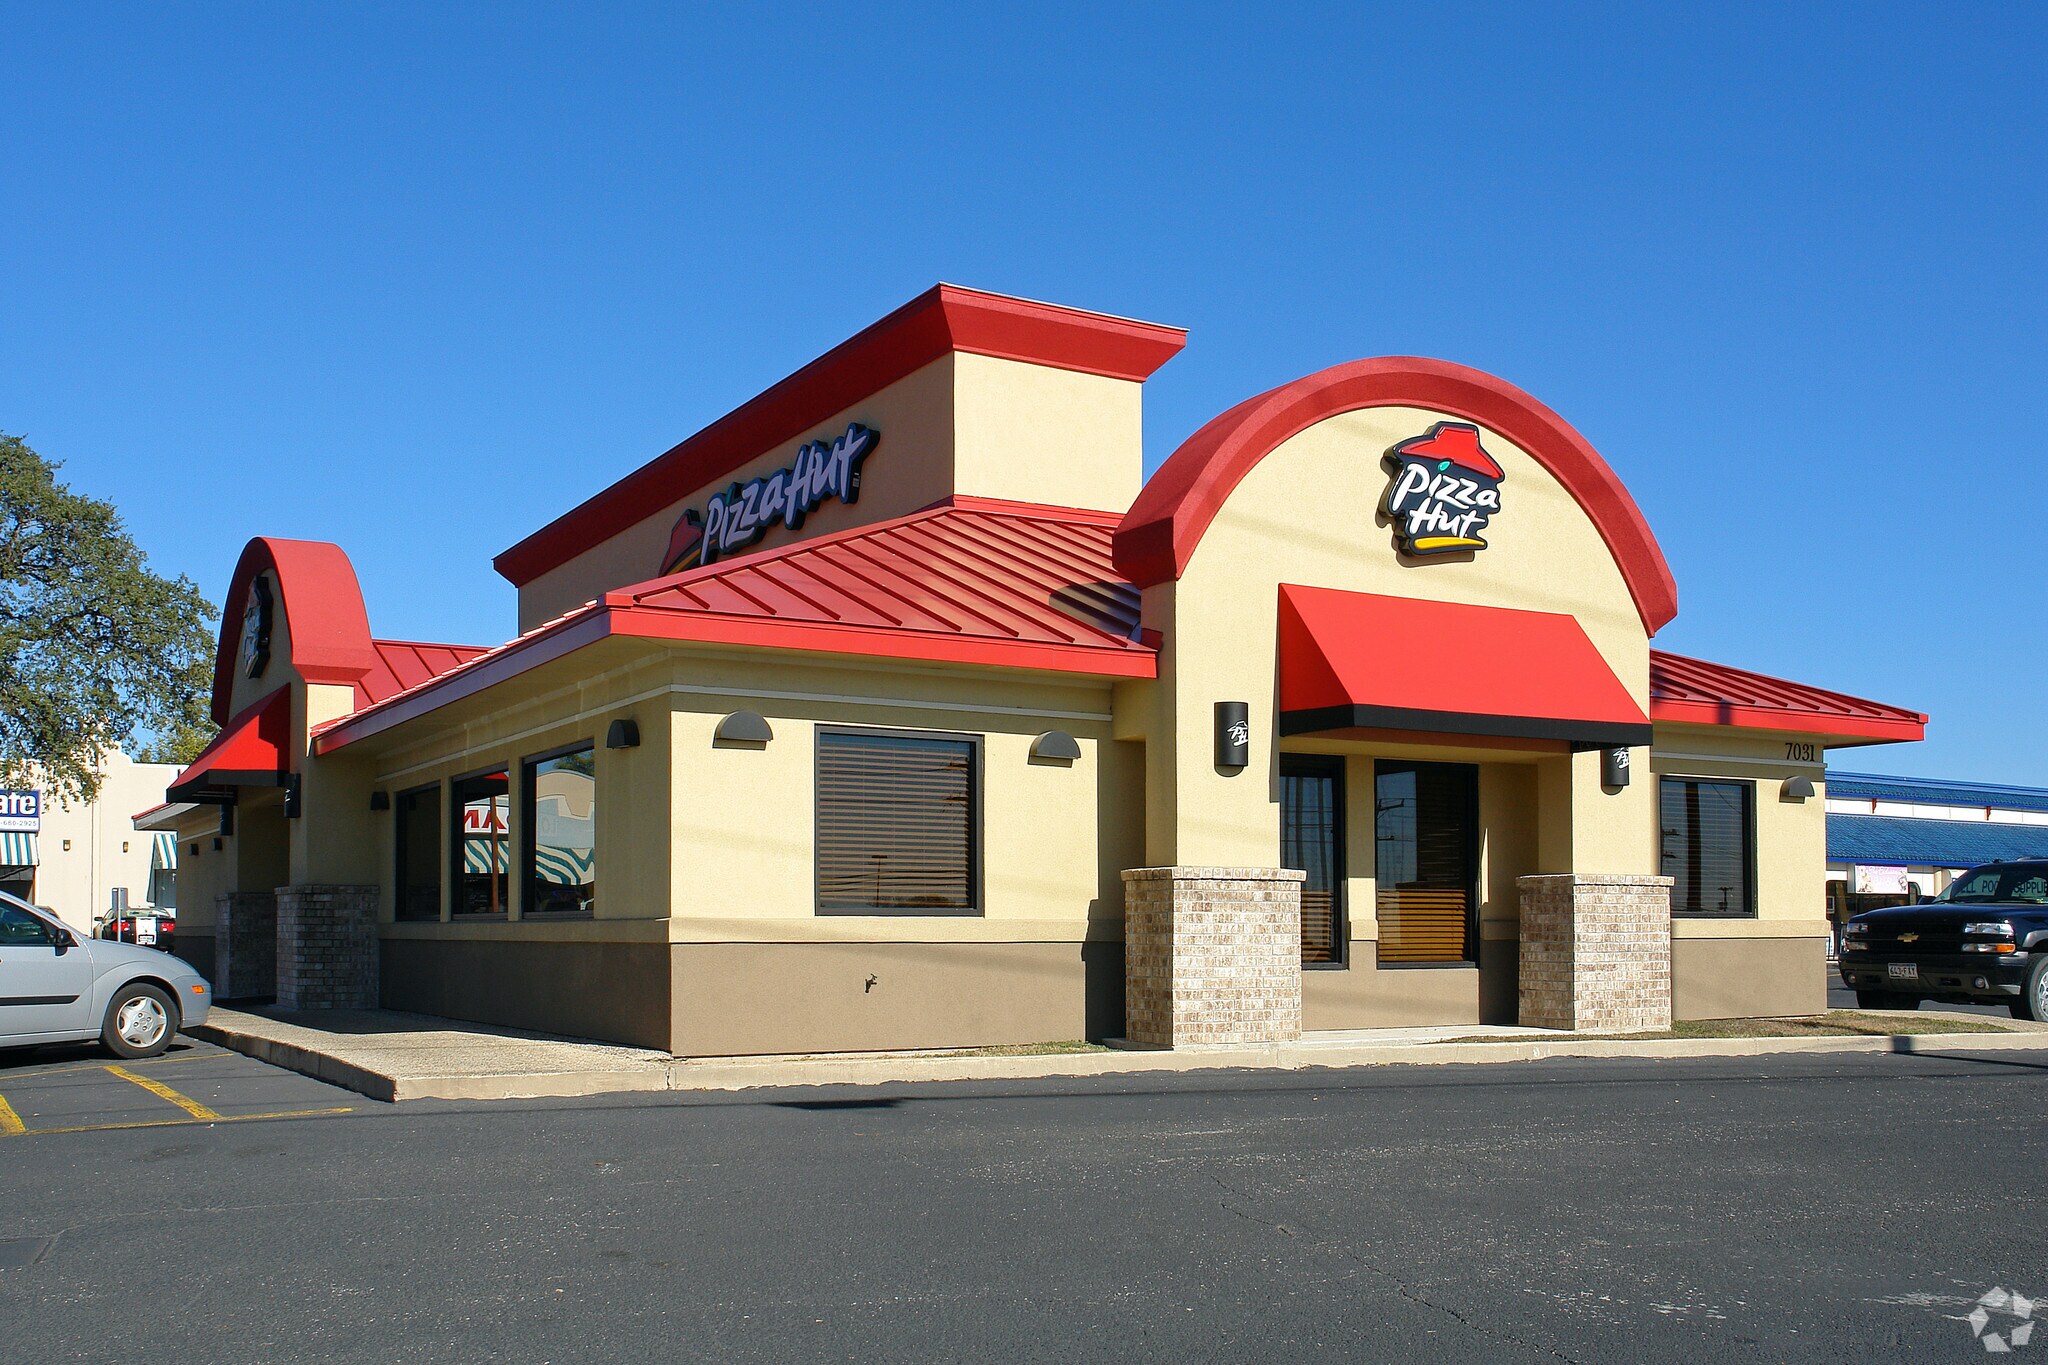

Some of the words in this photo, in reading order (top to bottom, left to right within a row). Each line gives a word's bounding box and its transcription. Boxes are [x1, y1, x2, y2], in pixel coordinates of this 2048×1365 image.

[700, 474, 785, 566] Pizza
[785, 428, 868, 525] Hut
[1392, 463, 1498, 511] Pizza
[1409, 497, 1486, 539] Hut
[1785, 742, 1815, 762] 7031
